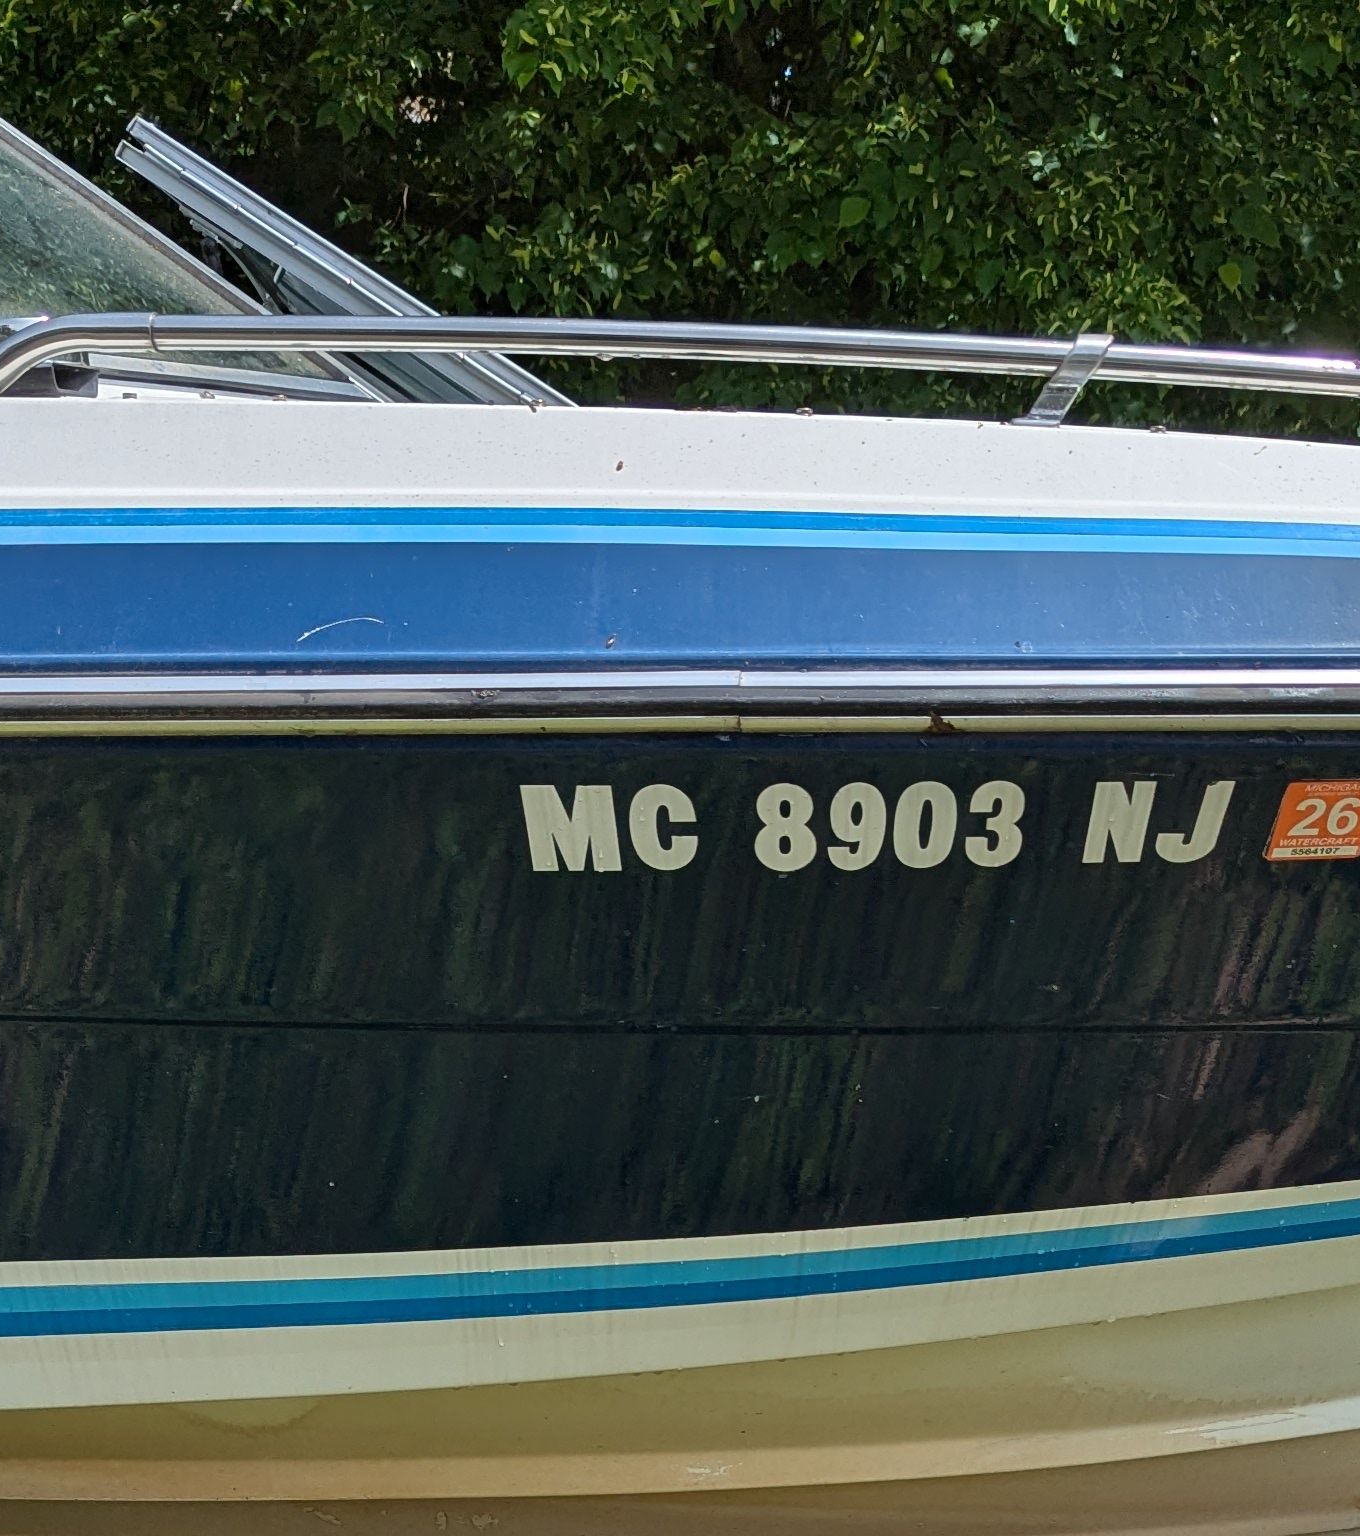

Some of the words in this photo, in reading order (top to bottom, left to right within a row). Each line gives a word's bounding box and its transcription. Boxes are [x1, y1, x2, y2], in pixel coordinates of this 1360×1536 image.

[520, 784, 698, 872] MC
[754, 780, 1026, 872] 8903
[1082, 780, 1236, 863] NJ
[1279, 838, 1359, 847] WATERCRAFT
